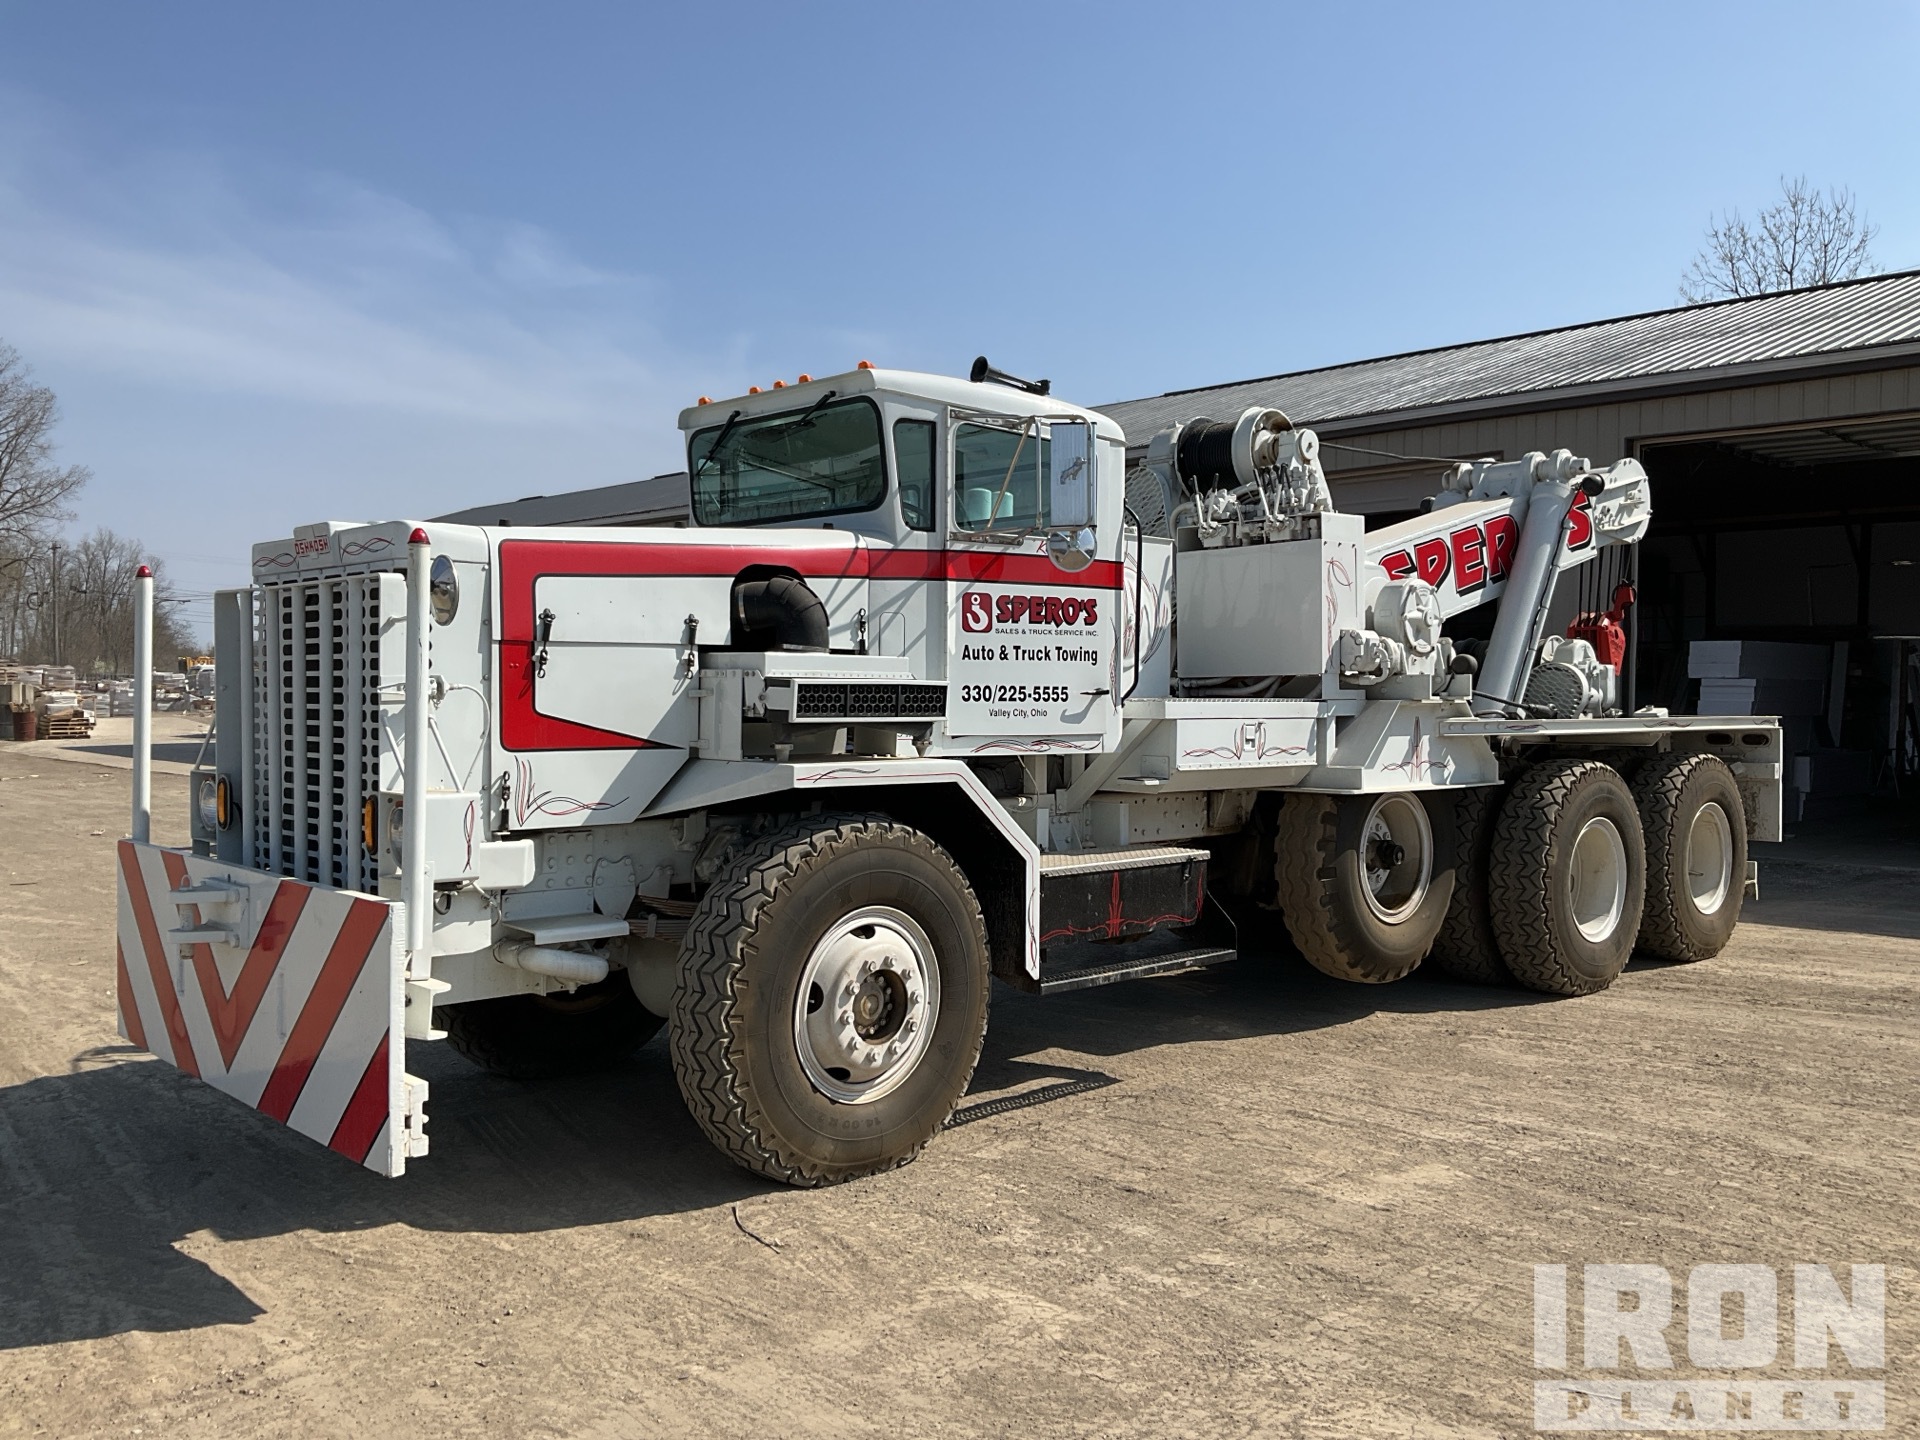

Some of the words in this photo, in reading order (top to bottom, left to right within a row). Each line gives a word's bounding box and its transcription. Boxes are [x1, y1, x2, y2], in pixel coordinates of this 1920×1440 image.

[294, 539, 328, 555] OSHKOSH
[996, 595, 1098, 628] SPERO'S
[962, 644, 995, 661] Auto
[999, 644, 1009, 661] &
[1013, 645, 1051, 661] Truck
[1055, 646, 1098, 666] Towing
[961, 684, 1069, 704] 330/225-5555
[989, 708, 1011, 719] Valley
[1012, 708, 1029, 719] City,
[1030, 708, 1048, 717] Ohio
